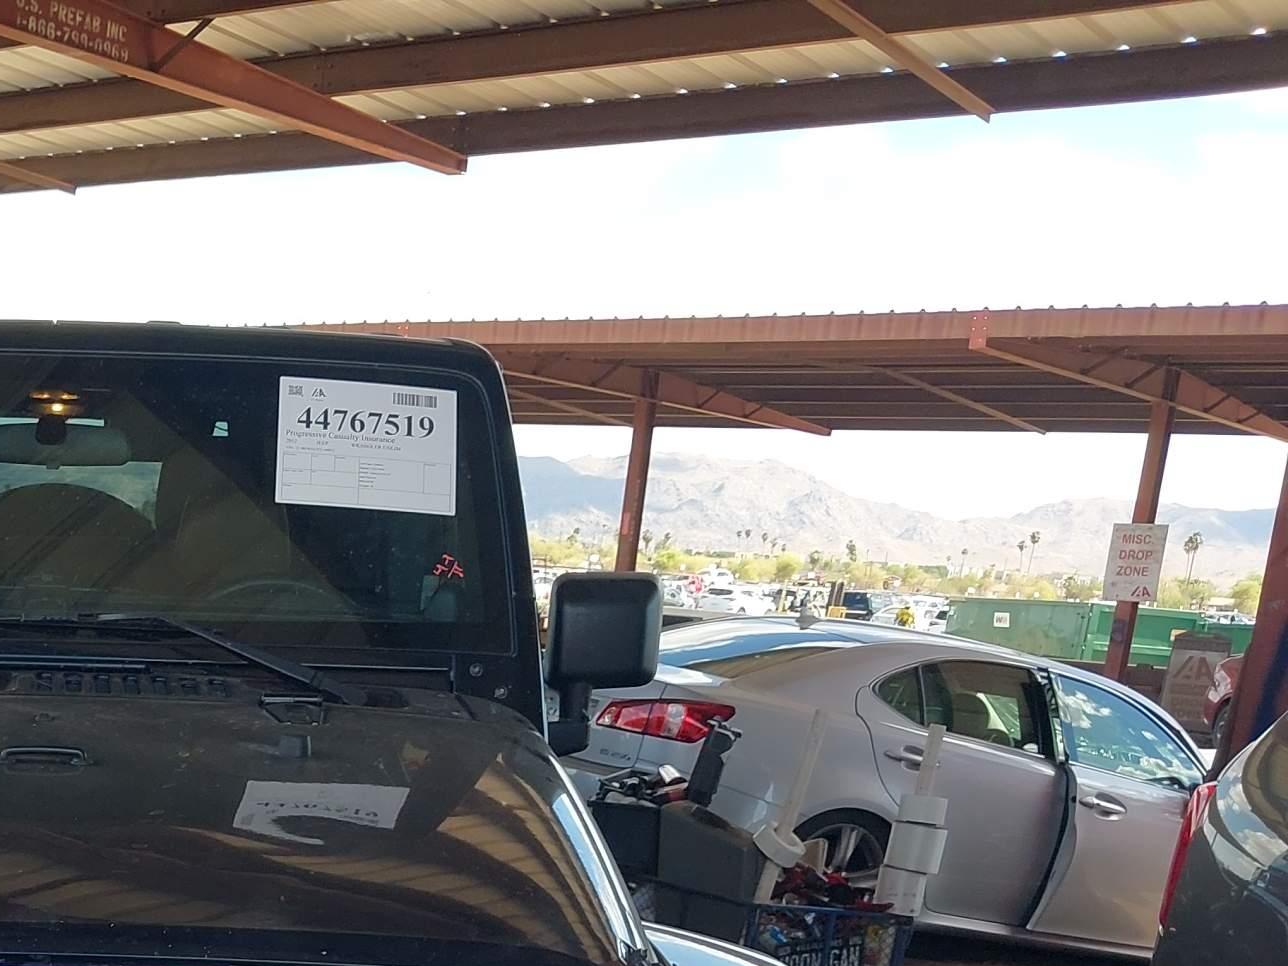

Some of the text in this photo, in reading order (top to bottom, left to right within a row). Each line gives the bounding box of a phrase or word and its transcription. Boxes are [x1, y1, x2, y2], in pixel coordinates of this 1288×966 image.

[49, 0, 102, 33] PREFAB
[297, 406, 435, 439] 44767519
[285, 428, 396, 444] Progressive Casualty Insurance
[1122, 533, 1154, 545] MISC.
[1118, 549, 1153, 561] DROP
[1115, 565, 1150, 577] ZONE
